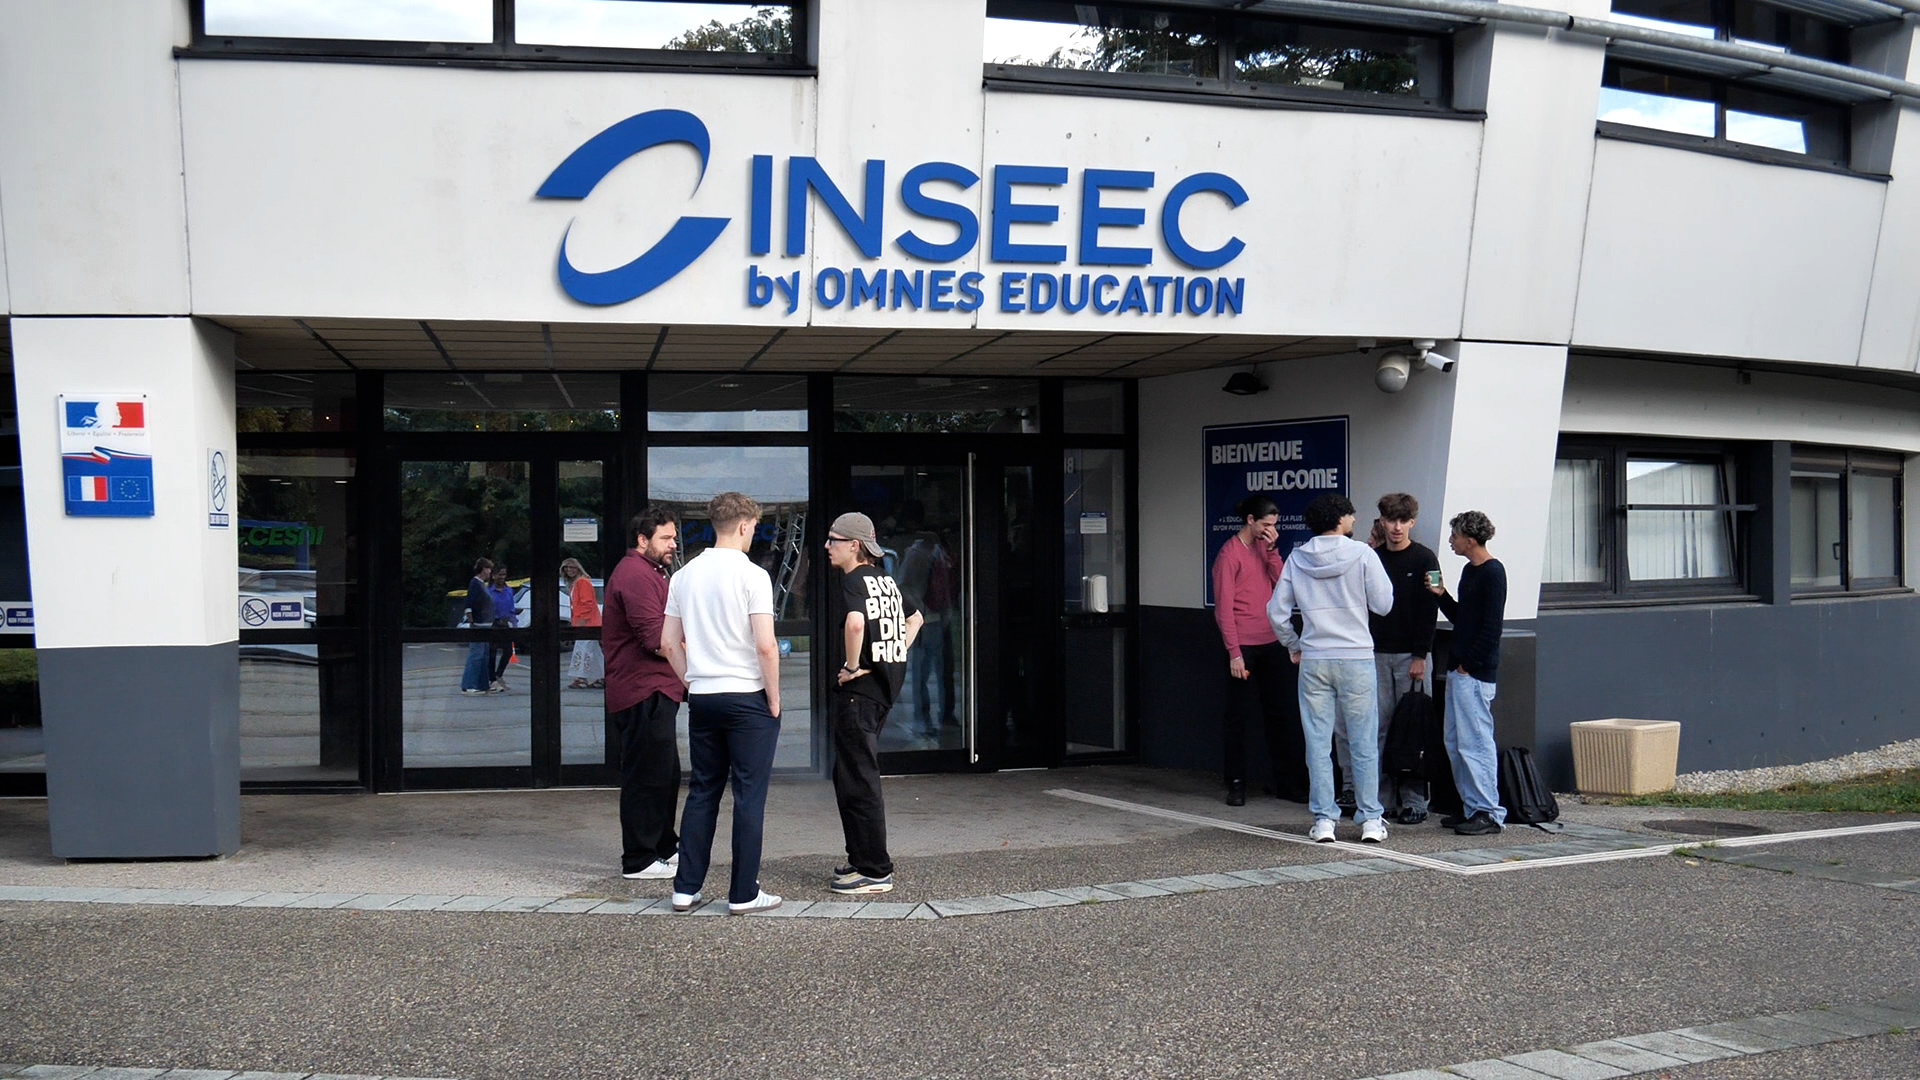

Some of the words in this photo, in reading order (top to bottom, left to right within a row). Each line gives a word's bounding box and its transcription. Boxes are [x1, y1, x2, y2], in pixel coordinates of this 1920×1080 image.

[749, 153, 1250, 270] INSEEC
[748, 264, 800, 315] by
[815, 266, 985, 313] OMNES
[1001, 271, 1244, 314] EDUCATION
[1211, 440, 1303, 465] BIENVENUE
[1246, 467, 1338, 492] WELCOME
[879, 617, 906, 641] DIE
